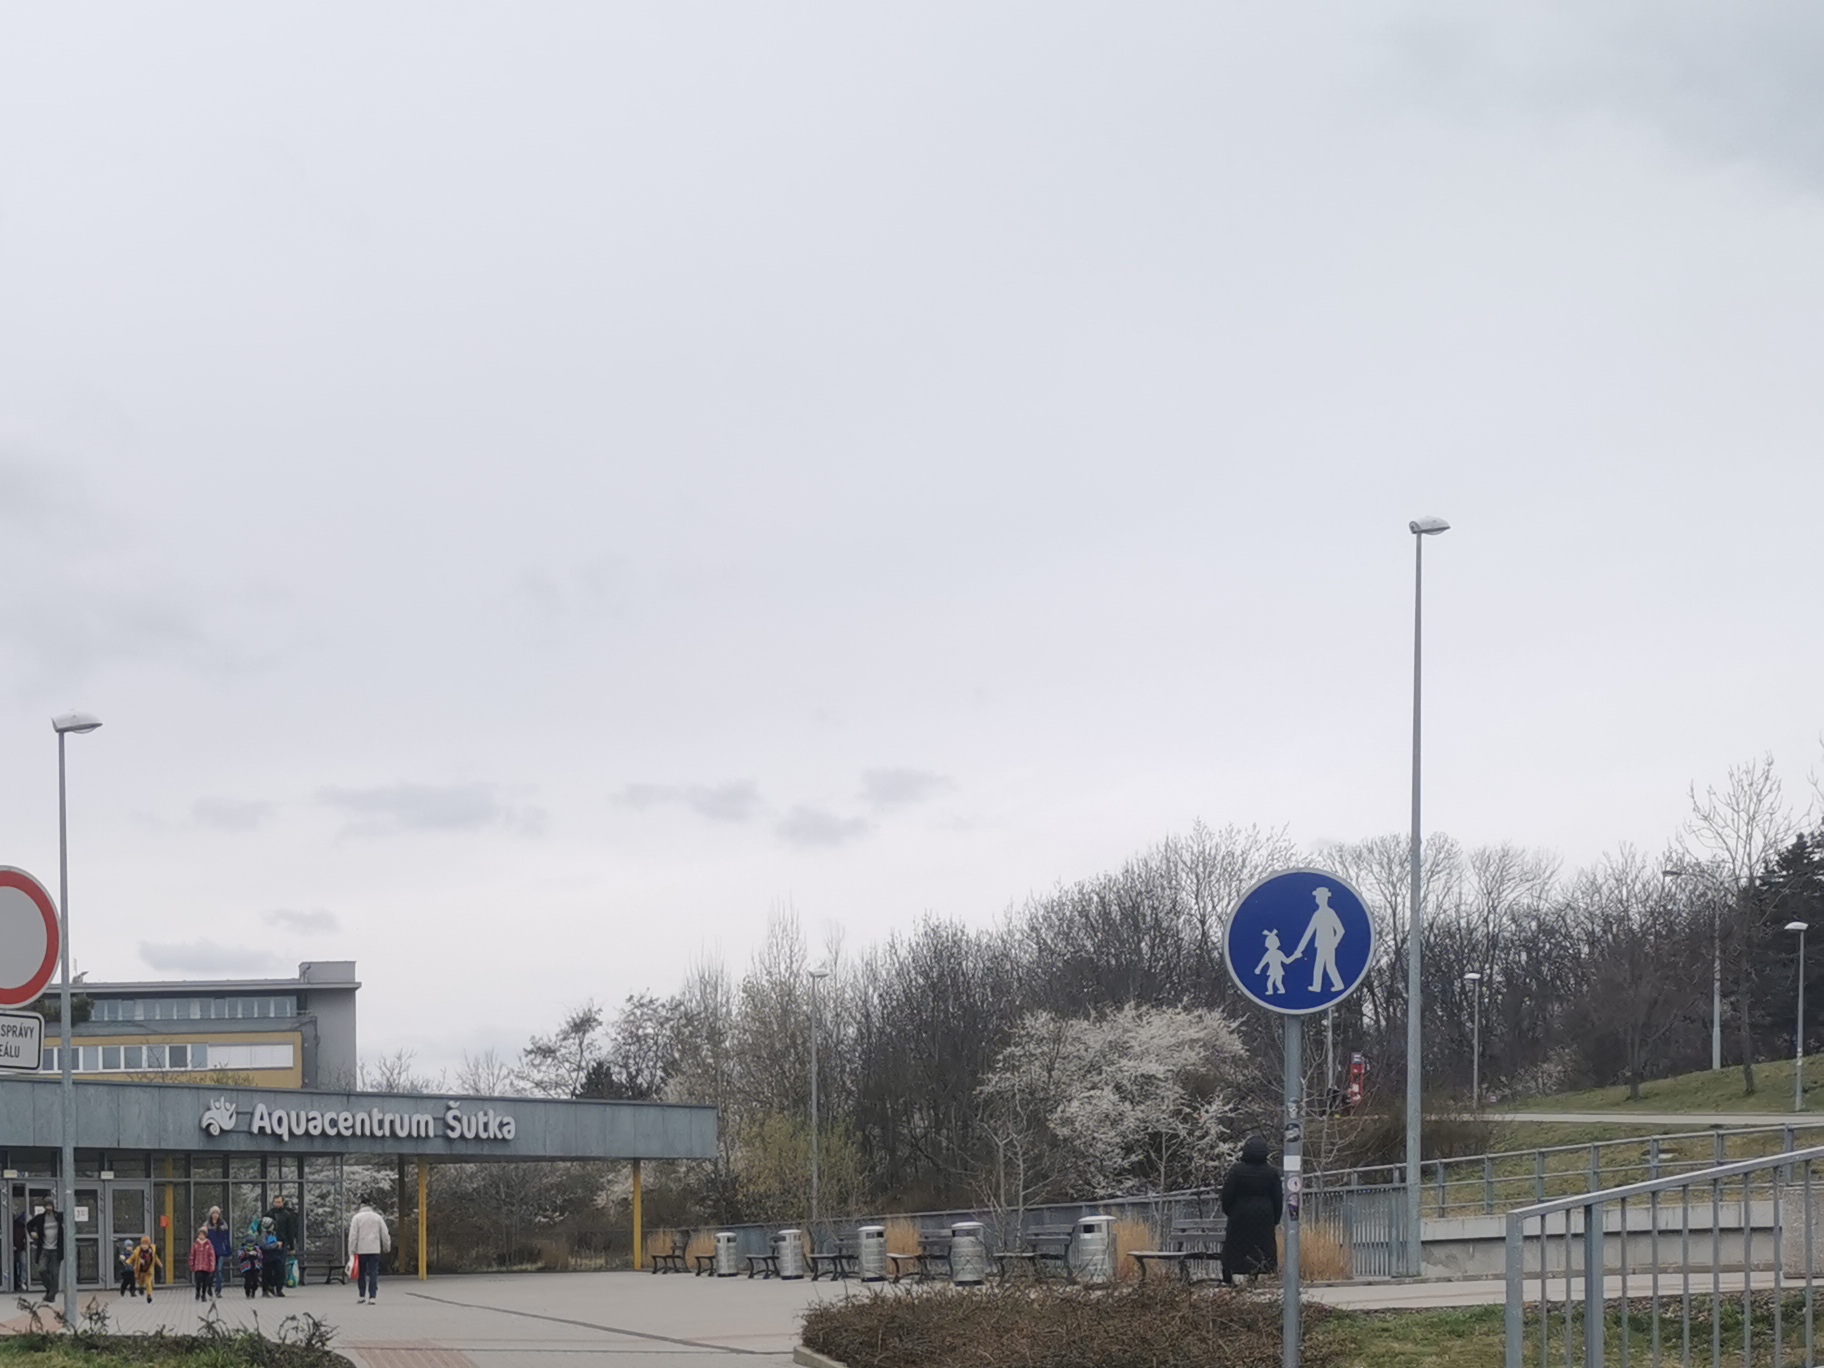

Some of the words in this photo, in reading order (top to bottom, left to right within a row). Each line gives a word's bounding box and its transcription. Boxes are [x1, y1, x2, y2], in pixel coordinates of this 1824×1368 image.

[0, 1022, 35, 1039] SPRÁVY
[251, 1103, 434, 1141] Aquacentrum
[445, 1100, 516, 1140] Šutka
